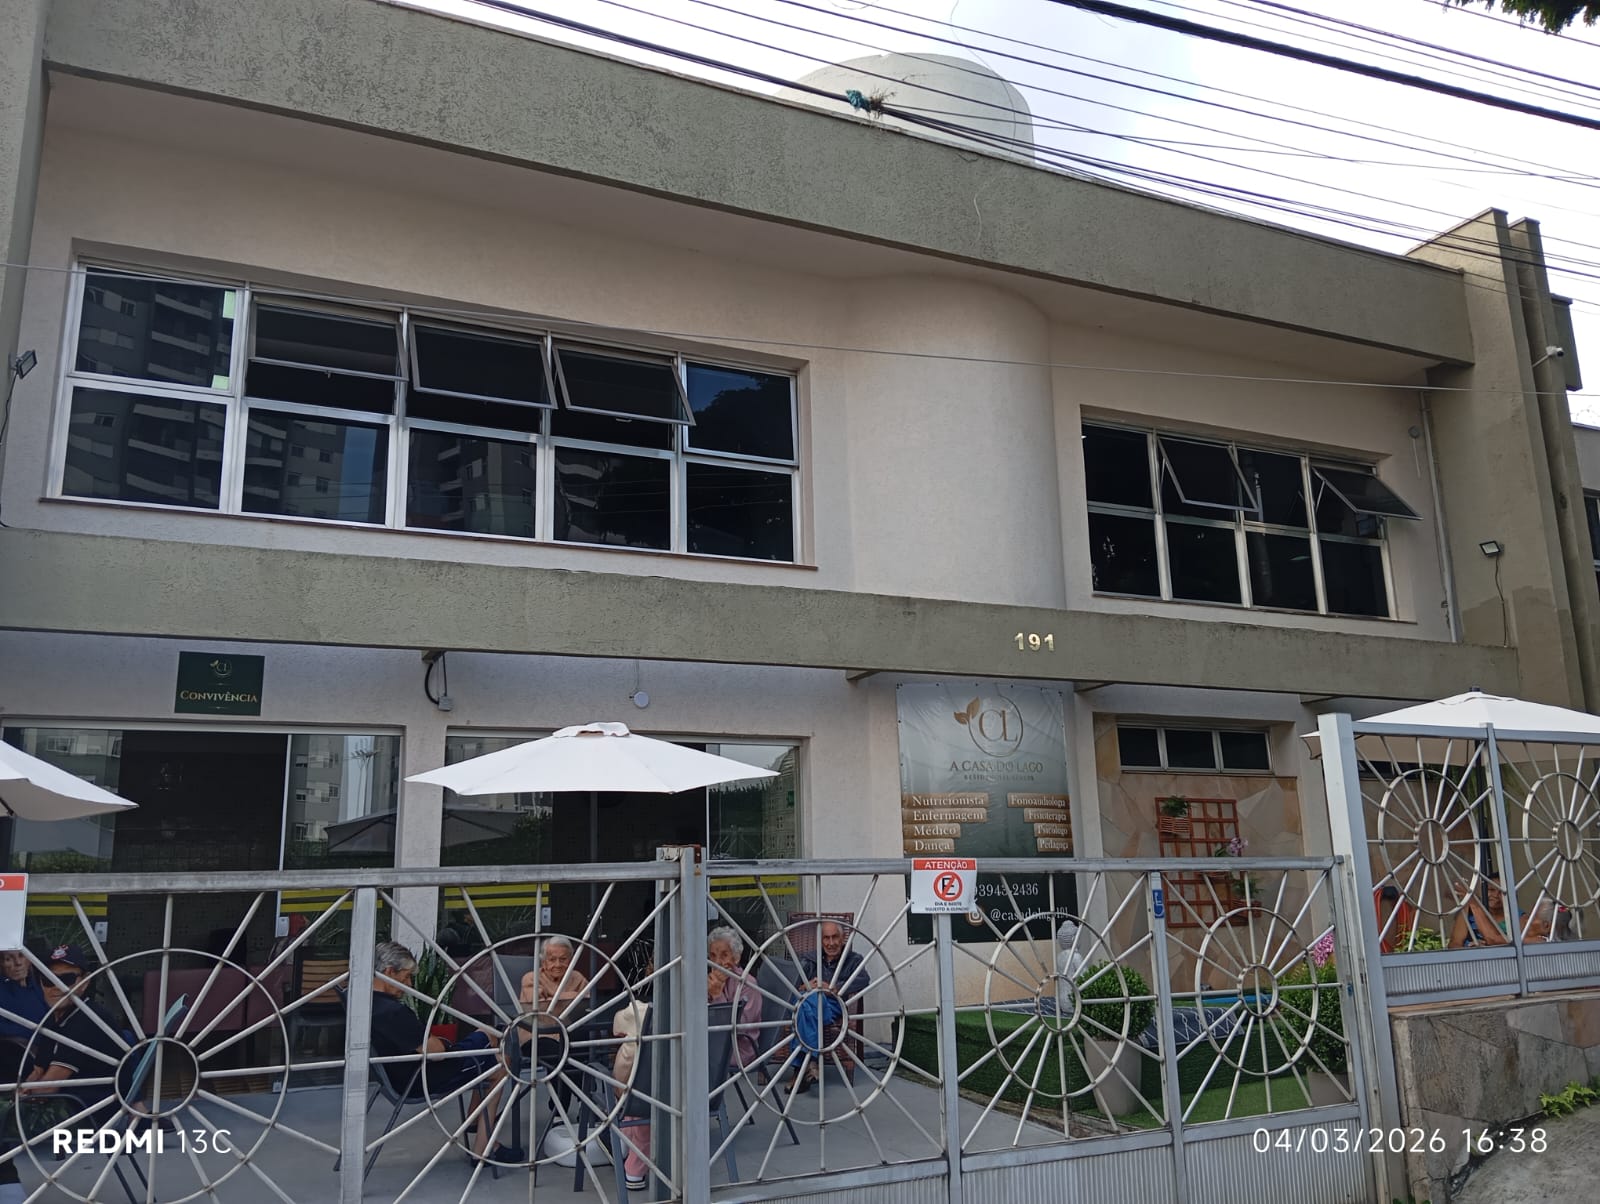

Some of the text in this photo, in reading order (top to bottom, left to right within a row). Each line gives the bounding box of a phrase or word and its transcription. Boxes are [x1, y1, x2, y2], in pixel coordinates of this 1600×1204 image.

[1014, 632, 1055, 651] 191
[950, 761, 1044, 773] A CASA DO LAGO
[912, 795, 984, 806] Nutricionista
[913, 810, 984, 821] Enfermagem
[914, 825, 957, 836] Médico
[914, 840, 951, 852] Dança
[924, 860, 968, 870] ATENÇÃO
